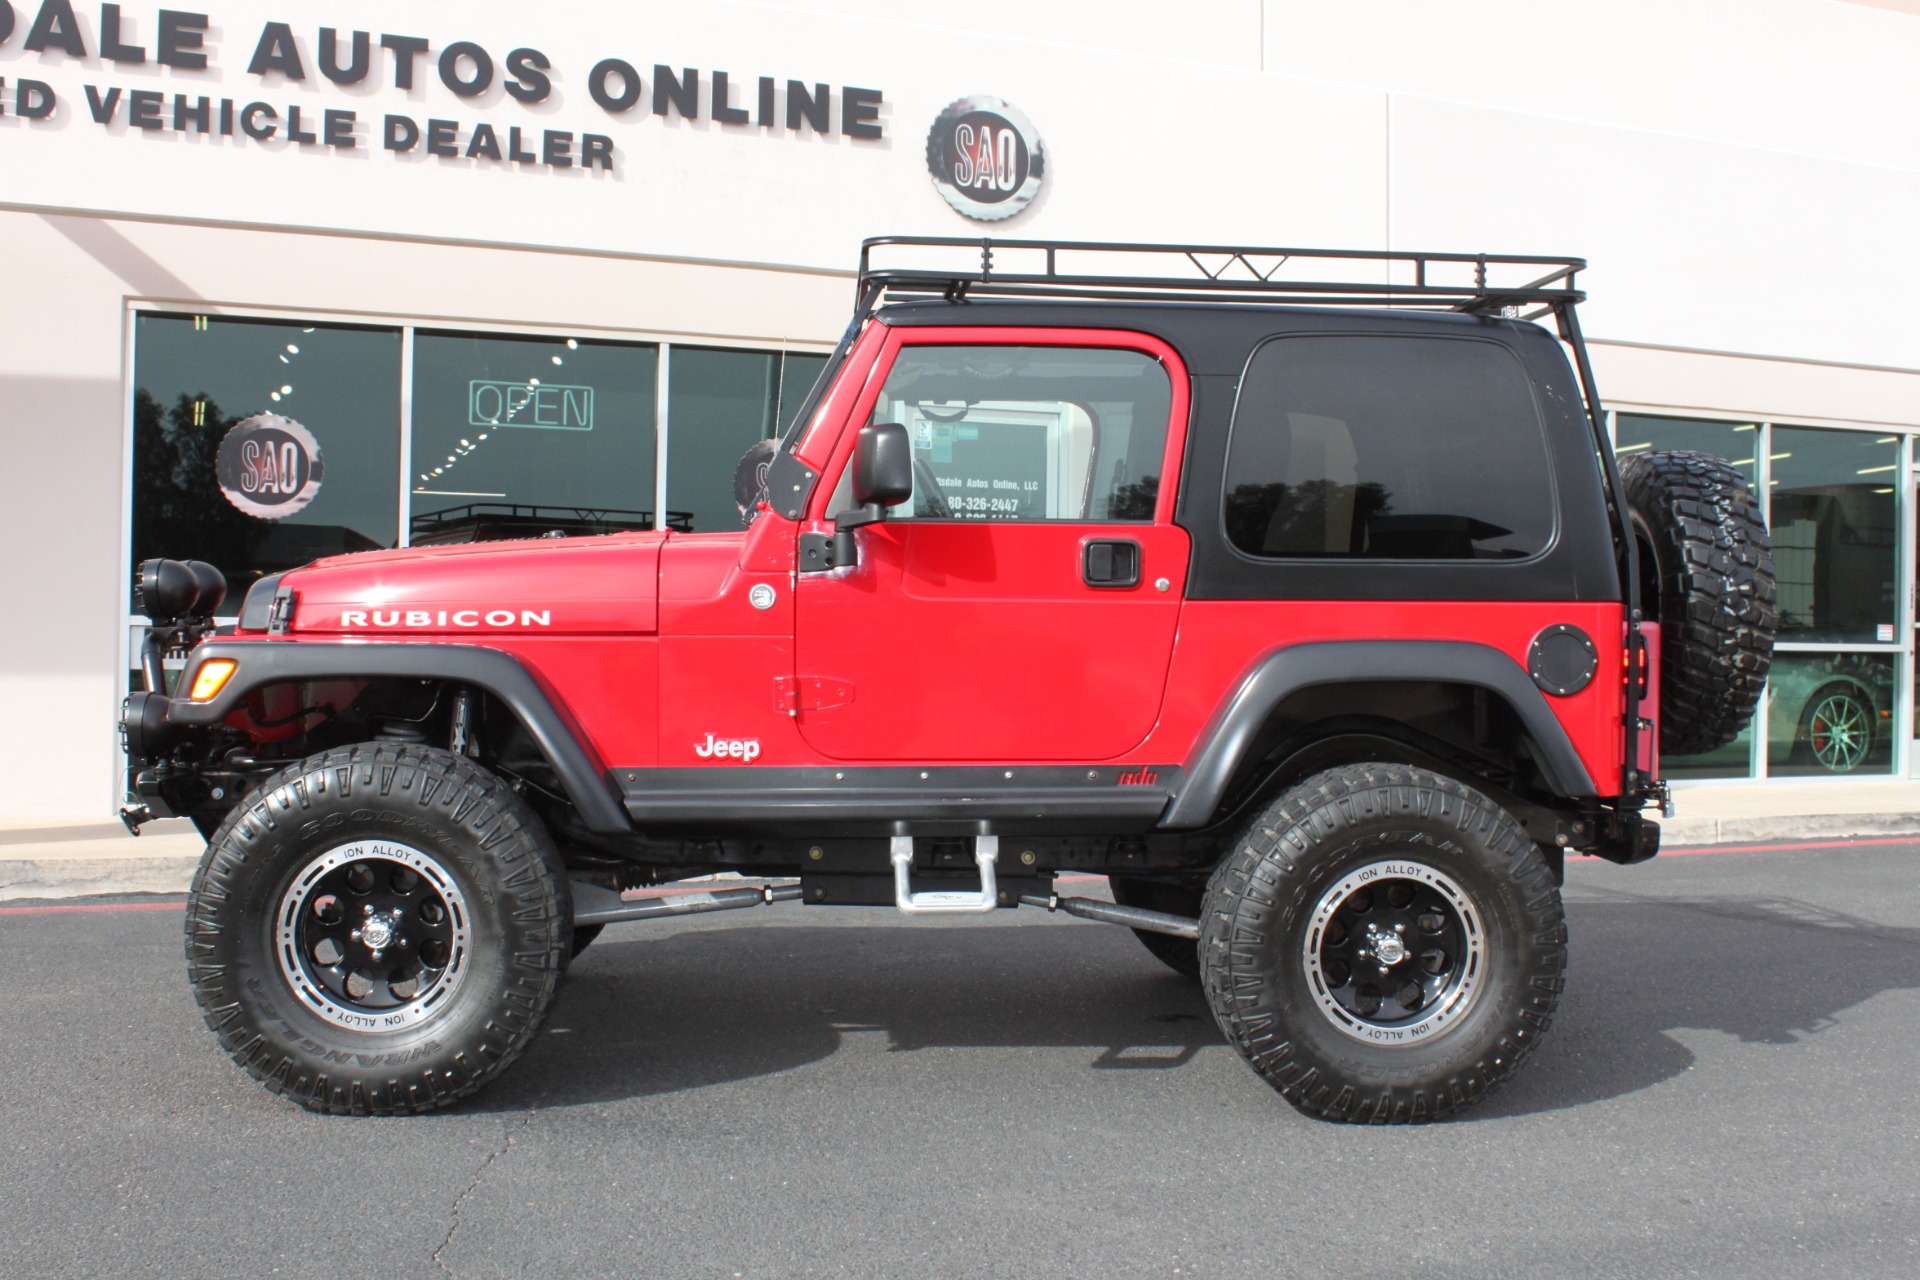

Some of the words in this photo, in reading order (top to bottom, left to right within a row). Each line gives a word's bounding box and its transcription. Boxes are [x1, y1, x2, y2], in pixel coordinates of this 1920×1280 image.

[0, 0, 209, 69] ALE
[247, 21, 551, 104] AUTOS
[588, 58, 883, 139] ONLINE
[0, 75, 56, 118] D
[84, 84, 357, 149] VEHICLE
[384, 114, 614, 171] DEALER
[955, 124, 1016, 191] SAO
[476, 385, 587, 426] OPEN
[241, 440, 298, 494] SAO
[966, 478, 988, 488] Autos
[993, 480, 1020, 491] Online,
[1024, 481, 1038, 491] LLC
[341, 610, 550, 627] RUBICON
[695, 734, 760, 762] Jeep
[344, 846, 363, 859] ION
[372, 845, 411, 861] ALLOY
[1358, 869, 1378, 882] ION
[1385, 865, 1422, 877] ALLOY
[337, 1013, 376, 1027] ALLOY
[385, 1013, 405, 1026] ION
[1367, 1029, 1403, 1040] ALLOY
[1411, 1023, 1430, 1037] ION
